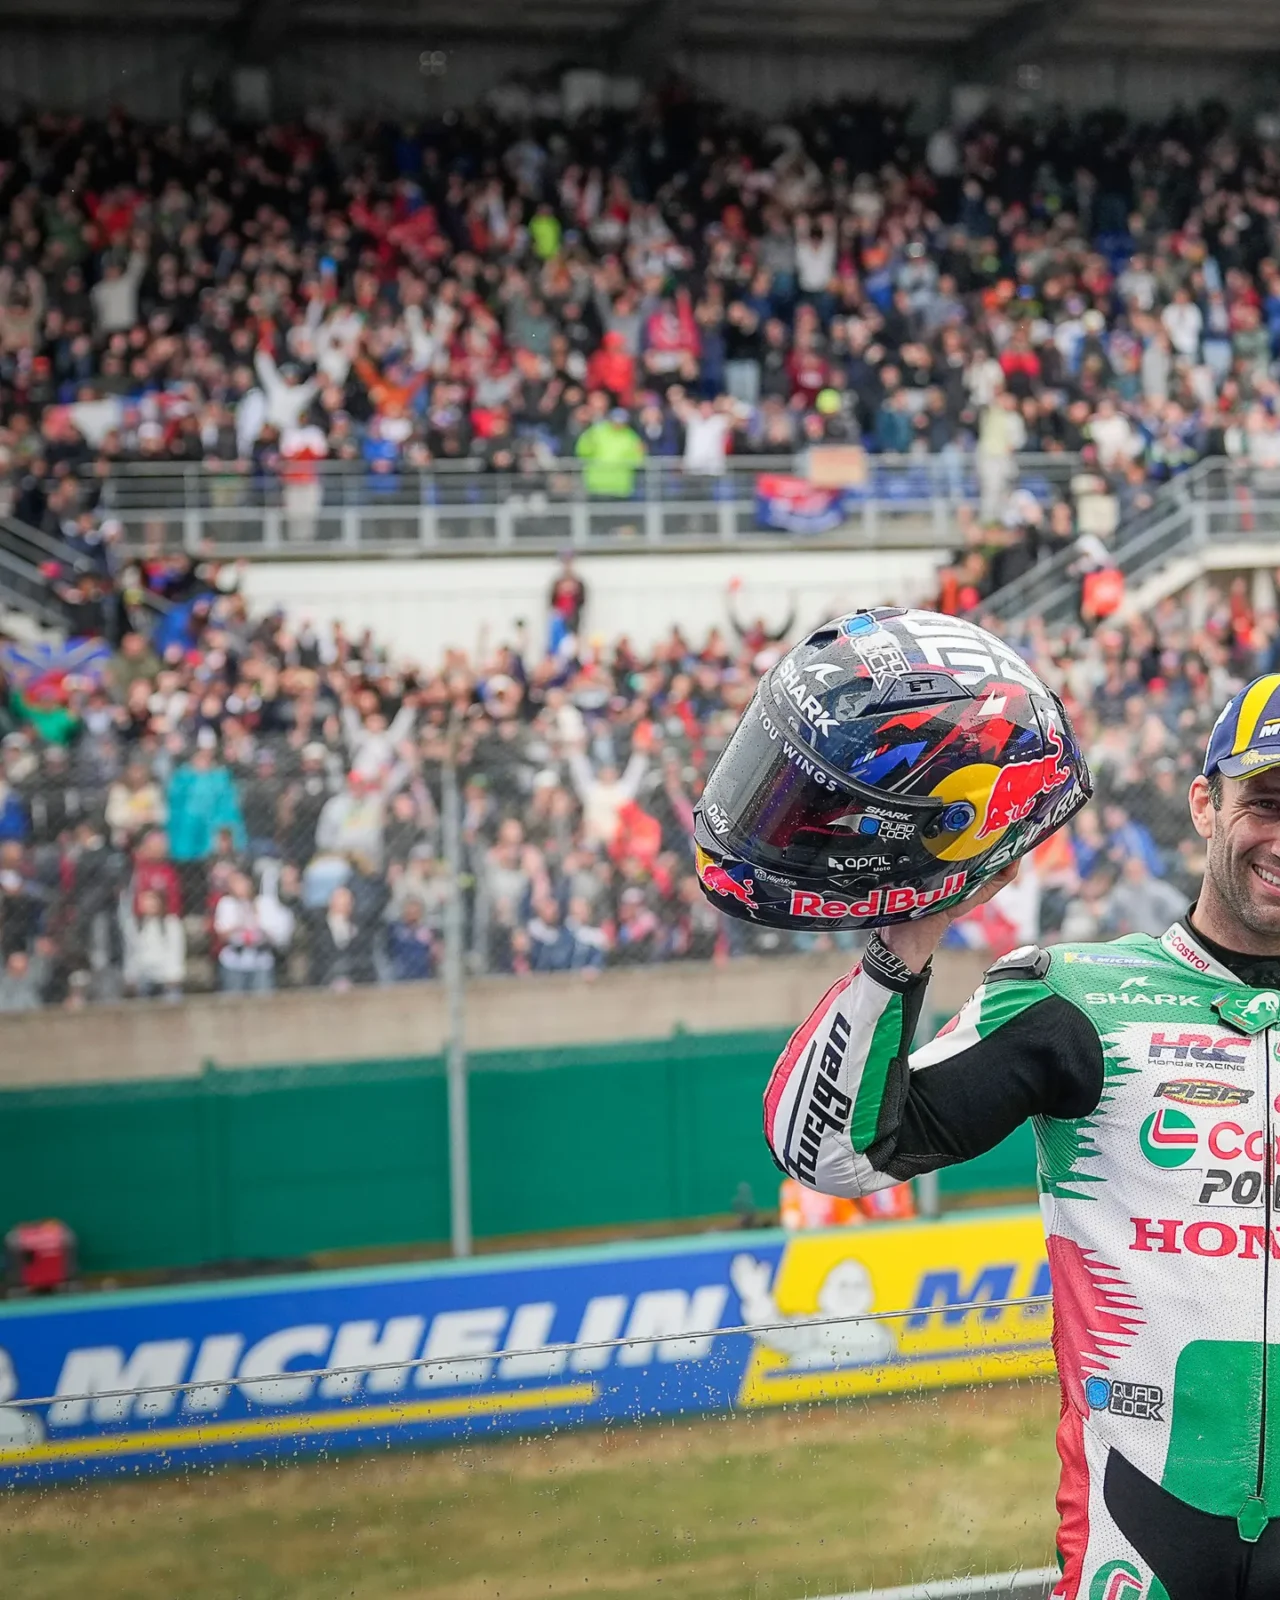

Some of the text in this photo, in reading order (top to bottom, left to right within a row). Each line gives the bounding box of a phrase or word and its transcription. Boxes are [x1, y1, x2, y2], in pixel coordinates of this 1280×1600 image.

[780, 659, 840, 738] SHARK
[759, 708, 838, 791] YOU WINGS
[706, 803, 730, 835] Dafy
[865, 806, 913, 821] SHARK
[985, 780, 1081, 869] SHARK
[878, 830, 913, 841] LOCK
[880, 821, 915, 834] QUAD
[790, 870, 968, 918] Red Bull
[1171, 936, 1210, 972] Castrol
[1084, 993, 1202, 1007] SHARK
[1148, 1032, 1252, 1064] HRC
[1148, 1059, 1245, 1071] Honda RACING
[1153, 1082, 1256, 1104] PBR
[47, 1284, 729, 1427] MICHELIN
[1112, 1383, 1161, 1402] QUAD
[1110, 1397, 1160, 1418] LOCK
